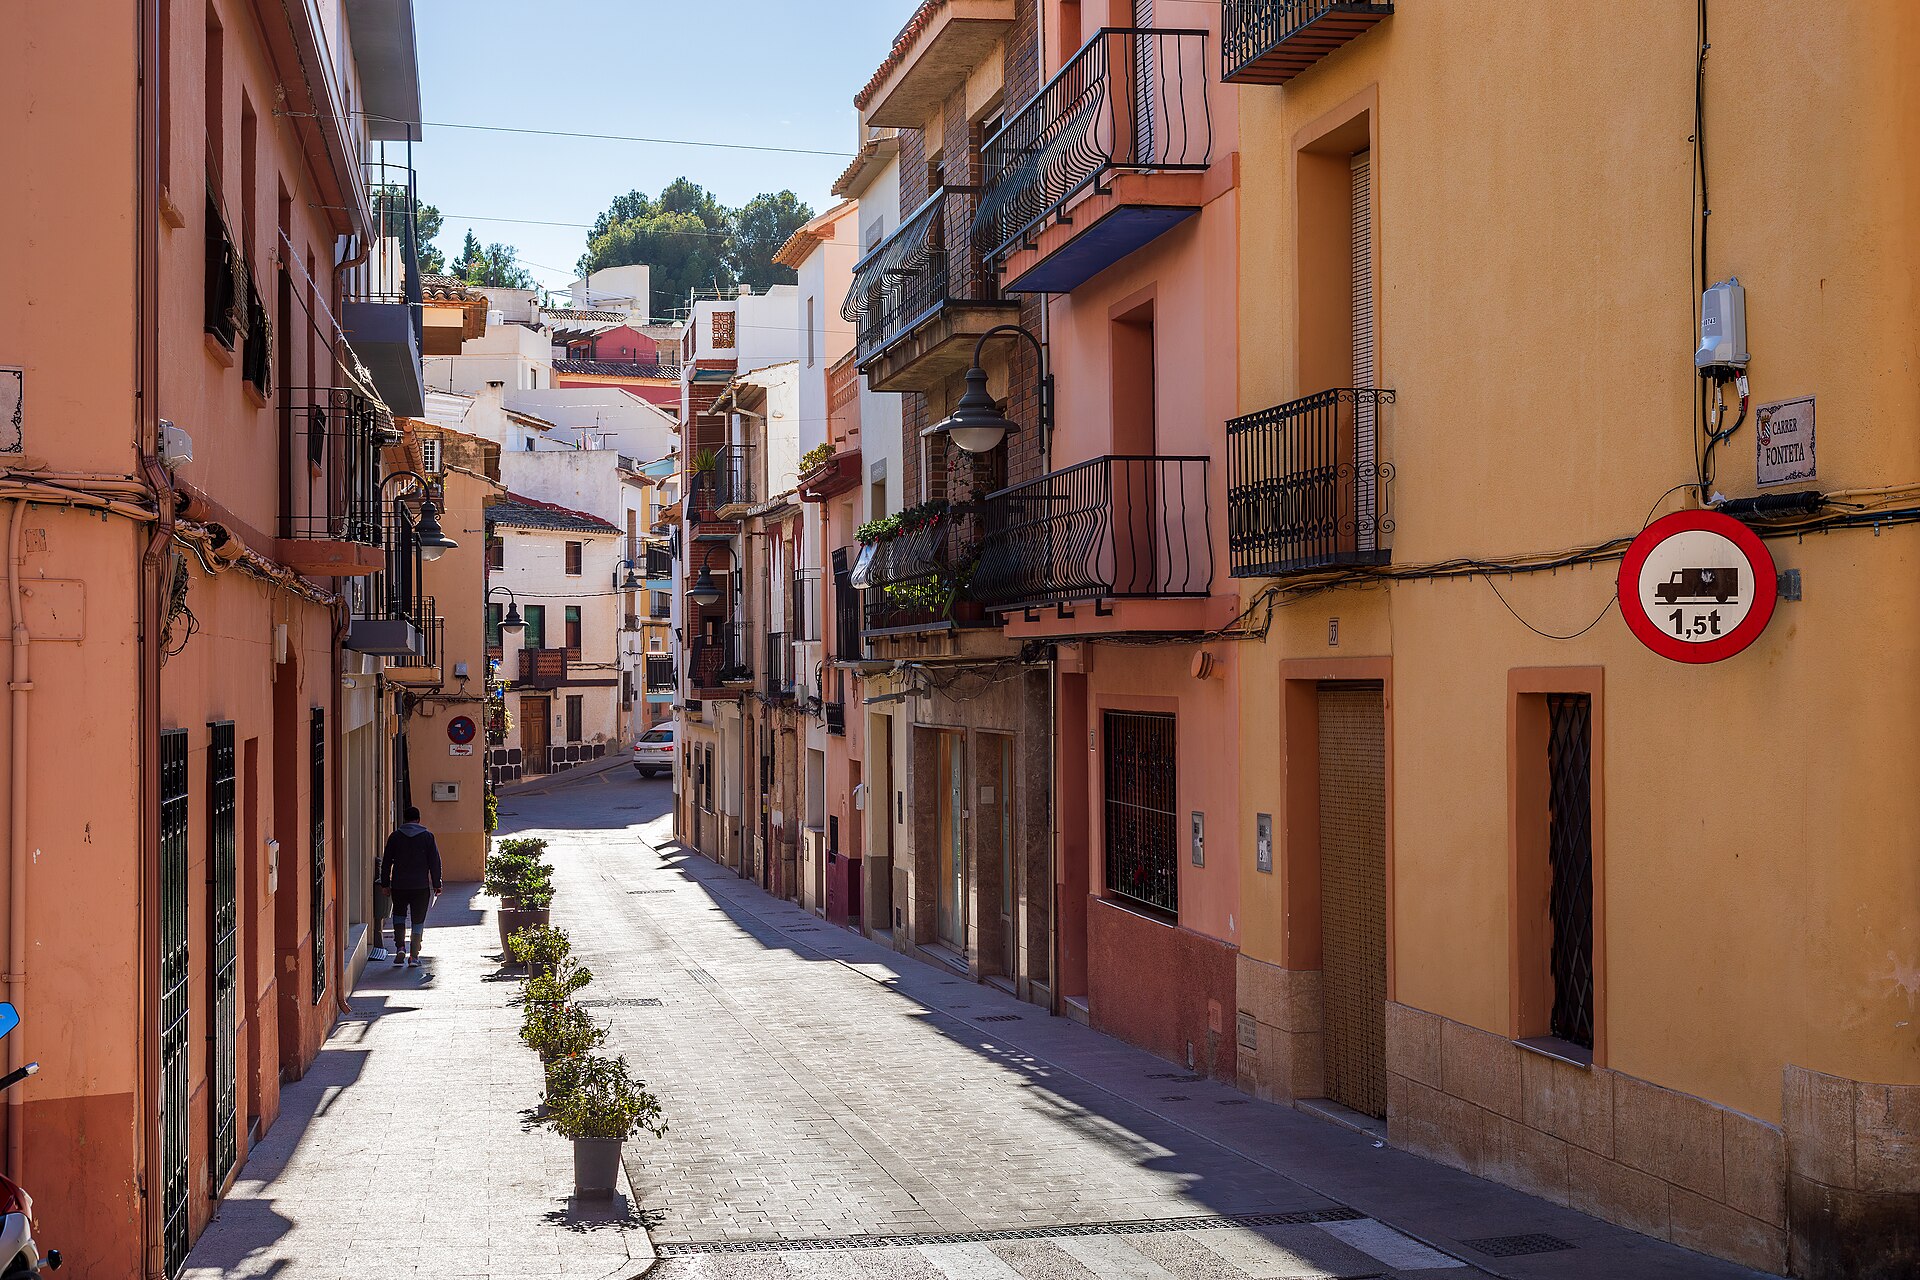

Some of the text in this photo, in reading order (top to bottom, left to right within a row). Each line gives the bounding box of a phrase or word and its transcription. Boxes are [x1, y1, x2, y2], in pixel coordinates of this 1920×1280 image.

[1772, 418, 1798, 435] CARRER
[1765, 443, 1805, 466] FONTETA
[1668, 608, 1721, 639] 1,5t
